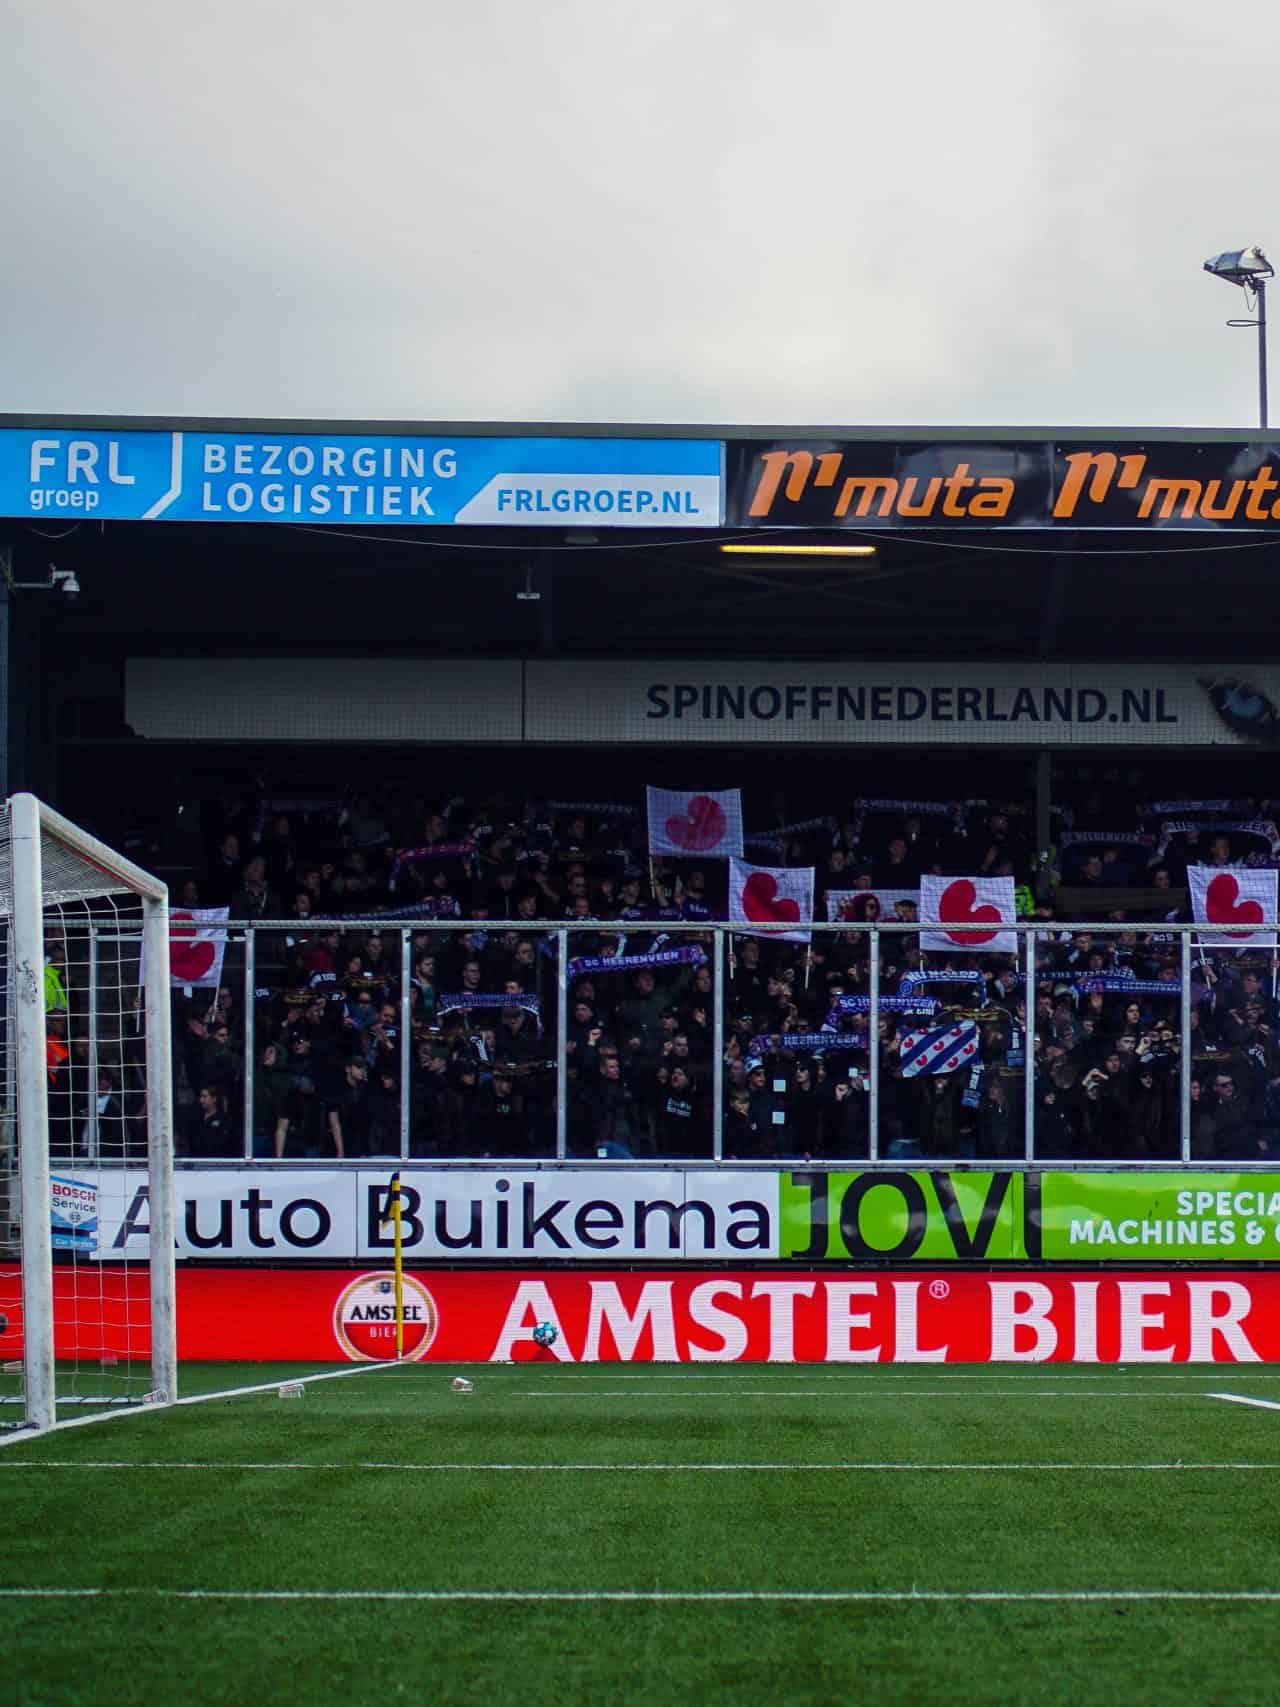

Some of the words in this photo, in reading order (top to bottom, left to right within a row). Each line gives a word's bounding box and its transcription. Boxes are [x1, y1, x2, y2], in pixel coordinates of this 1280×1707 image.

[30, 440, 135, 485] FRL
[203, 444, 458, 478] BEZORGING
[30, 487, 98, 510] groep
[202, 483, 436, 516] LOGISTIEK
[497, 488, 700, 514] FRLGROEP.NL
[833, 463, 1014, 518] muta
[647, 684, 1178, 722] SPINOFFNEDERLAND.NL
[52, 1184, 96, 1202] BOSCH
[52, 1197, 96, 1213] Service
[114, 1185, 332, 1250] Auto
[367, 1179, 771, 1250] Buikema
[1069, 1220, 1235, 1244] MACHINES
[1245, 1221, 1265, 1245] &
[350, 1305, 421, 1320] AMSTEL
[988, 1281, 1263, 1362] BIER
